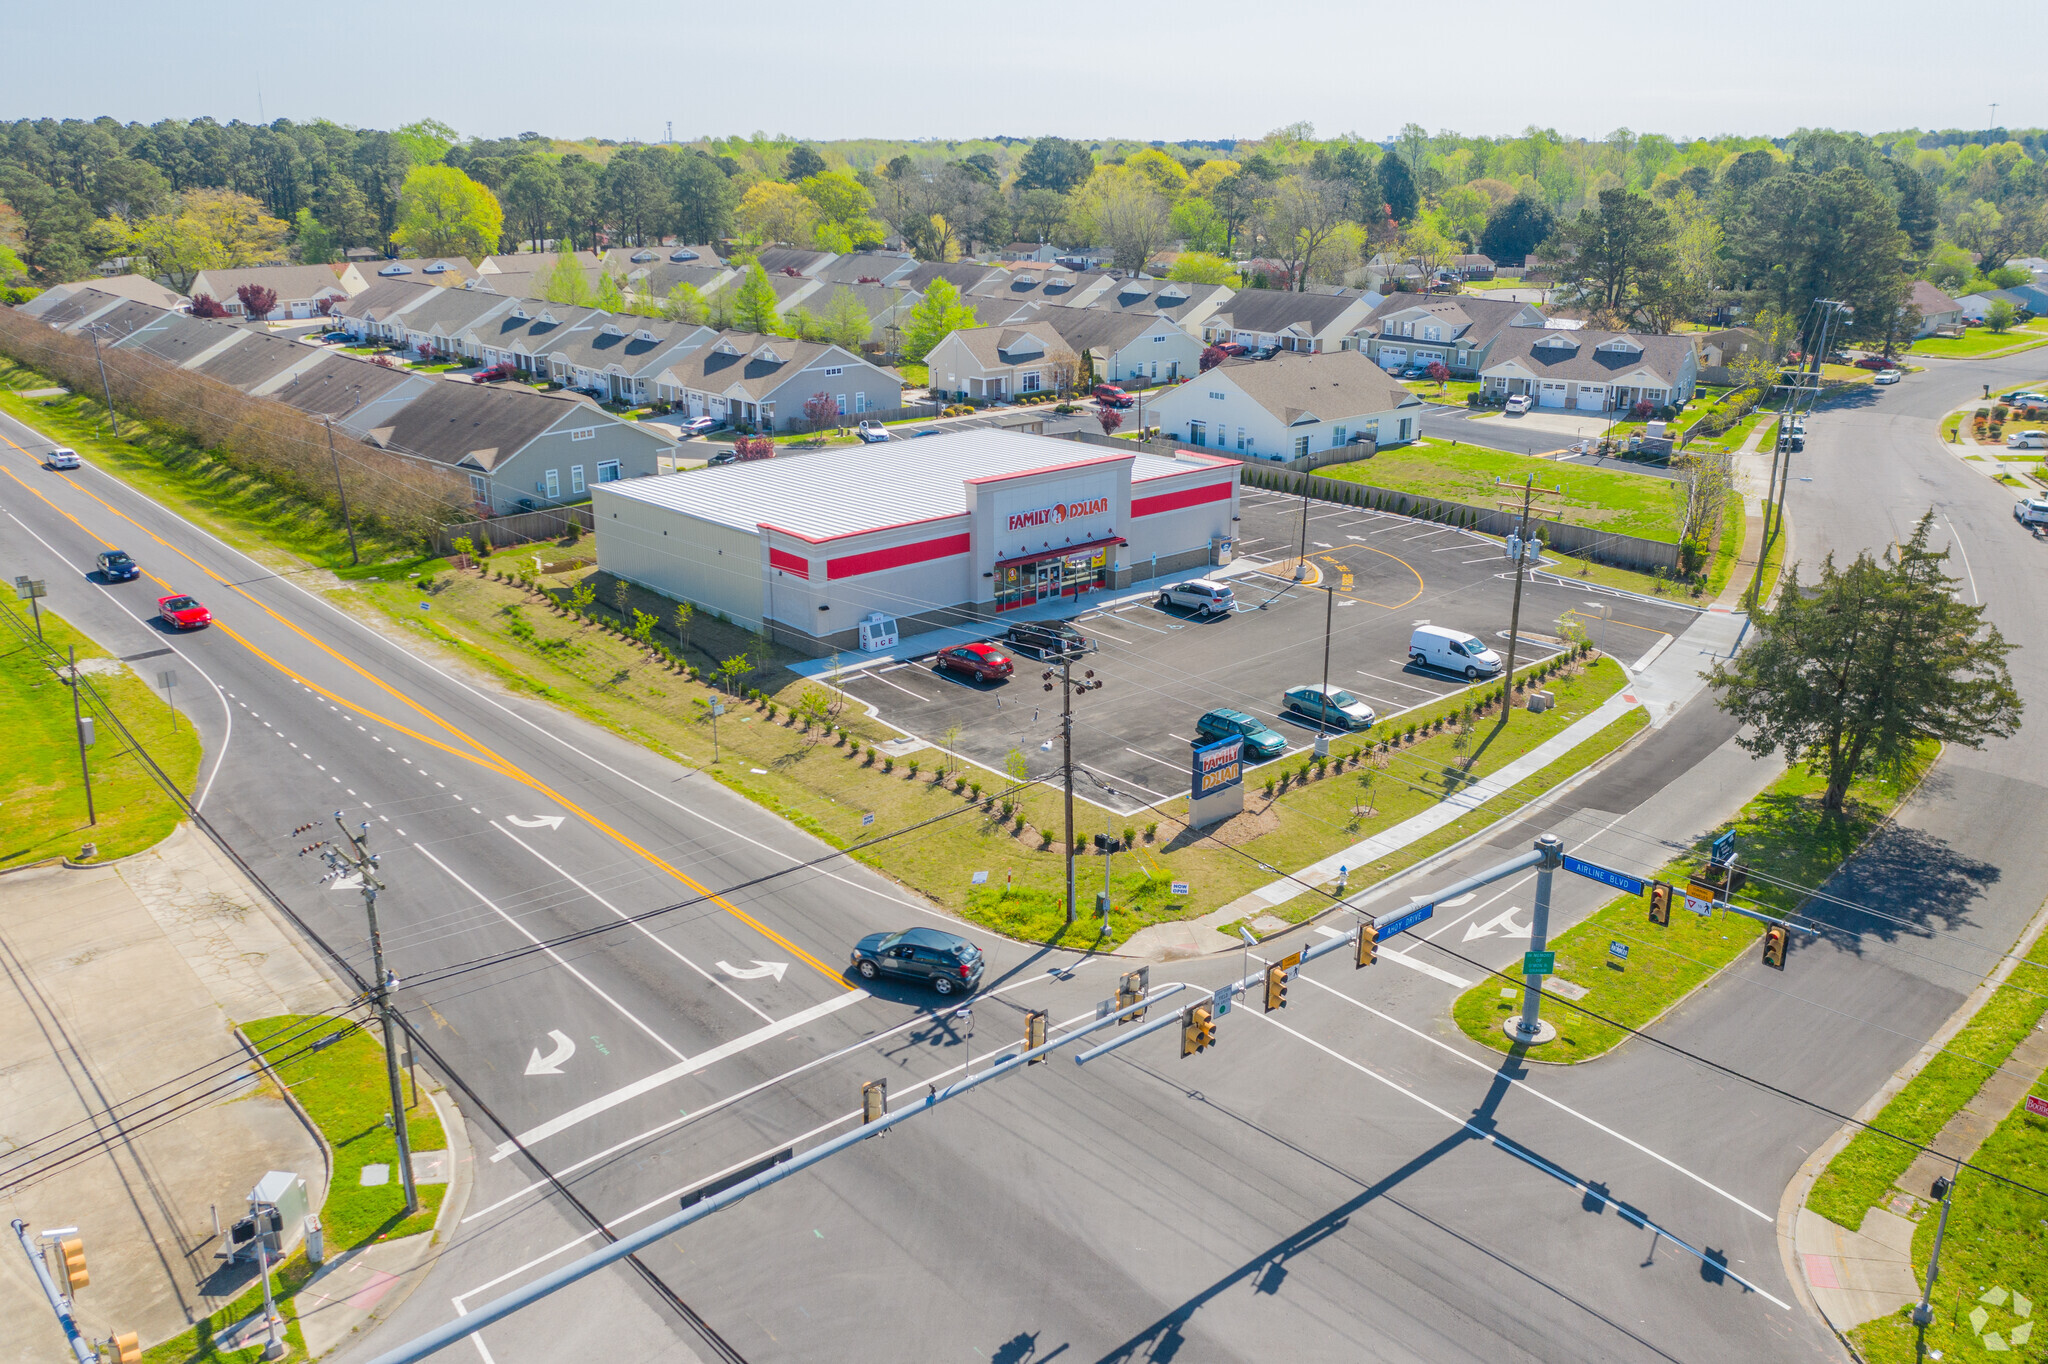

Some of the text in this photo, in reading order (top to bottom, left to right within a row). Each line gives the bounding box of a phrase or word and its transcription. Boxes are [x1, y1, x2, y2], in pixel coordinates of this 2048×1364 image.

[1008, 497, 1108, 530] FAMILY DOLLAR
[875, 637, 893, 648] ICE
[1203, 745, 1239, 771] FAMILY
[1202, 763, 1239, 791] DOLLAR
[1576, 863, 1629, 888] AIRLINE BLVD
[1386, 911, 1422, 935] AHOY DRIVE
